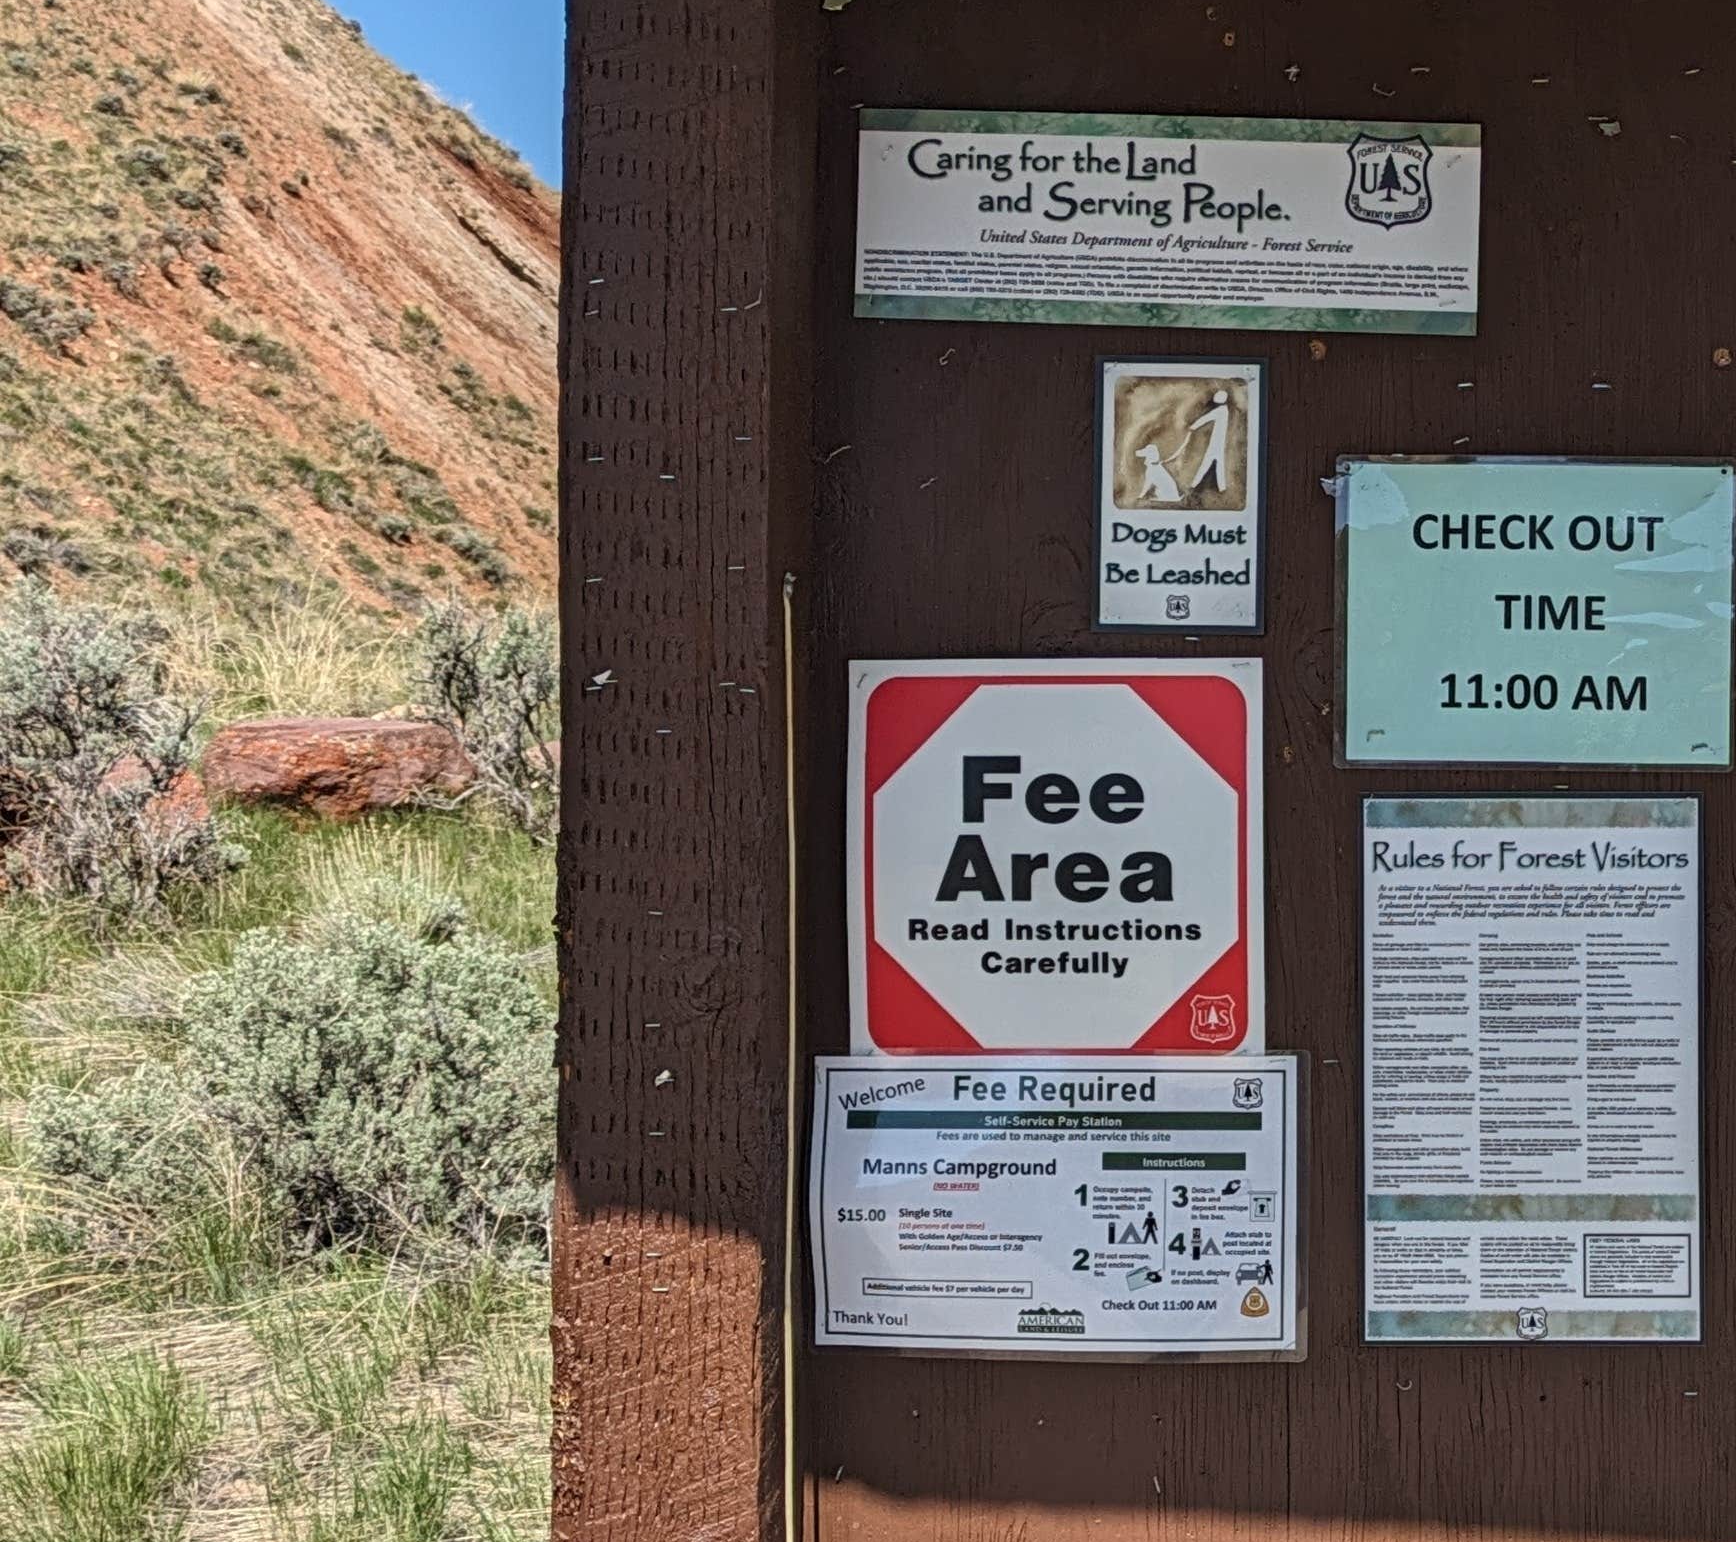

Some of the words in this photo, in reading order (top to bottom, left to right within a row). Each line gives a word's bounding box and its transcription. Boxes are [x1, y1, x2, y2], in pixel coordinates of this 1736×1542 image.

[907, 138, 1012, 181] Caring
[1020, 141, 1062, 172] for
[1073, 142, 1121, 173] the
[1126, 141, 1195, 180] Land
[978, 182, 1032, 213] and
[1043, 181, 1172, 226] Serving
[1182, 182, 1291, 233] People.
[980, 228, 1027, 243] United
[1029, 230, 1068, 245] States
[1071, 231, 1153, 249] Department
[1156, 234, 1173, 251] of
[1173, 234, 1249, 252] Agriculture
[1262, 237, 1303, 251] Forest
[1305, 238, 1353, 253] Service
[1111, 522, 1178, 553] Dogs
[1184, 524, 1247, 544] Must
[1413, 514, 1554, 550] CHECK
[1568, 515, 1664, 552] OUT
[1105, 563, 1140, 583] Be
[1146, 557, 1250, 585] Leashed
[1495, 594, 1606, 630] TIME
[1440, 673, 1558, 710] 11:00
[1571, 675, 1648, 710] AM
[962, 755, 1145, 824] Fee
[1372, 840, 1445, 872] Rules
[1451, 839, 1493, 869] for
[1498, 840, 1587, 872] Forest
[1591, 841, 1690, 871] Visitors
[935, 834, 1174, 903] Area
[908, 919, 989, 941] Read
[1004, 918, 1202, 941] Instructions
[981, 951, 1129, 978] Carefully
[838, 1078, 926, 1109] Welcome
[953, 1075, 1006, 1101] Fee
[1019, 1075, 1156, 1108] Required
[984, 1116, 1055, 1127] Self-Service
[1058, 1117, 1078, 1128] Pay
[1082, 1117, 1122, 1127] Station
[936, 1131, 959, 1140] Fees
[962, 1132, 979, 1141] are
[982, 1131, 1006, 1141] used
[1009, 1132, 1020, 1141] to
[1023, 1133, 1065, 1143] manage
[1068, 1131, 1087, 1141] and
[1090, 1132, 1127, 1141] service
[1130, 1132, 1150, 1141] this
[1151, 1132, 1171, 1141] site
[863, 1159, 927, 1175] Manns
[933, 1158, 1056, 1179] Campground
[1143, 1158, 1206, 1168] Instructions
[1074, 1184, 1087, 1207] 1
[1093, 1186, 1119, 1194] Occupy
[1171, 1185, 1189, 1208] 3
[837, 1208, 886, 1223] $15.00
[899, 1208, 930, 1219] Single
[933, 1208, 952, 1218] Site
[1168, 1232, 1186, 1255] 4
[1072, 1248, 1090, 1271] 2
[956, 1286, 968, 1294] per
[997, 1286, 1009, 1295] per
[1011, 1286, 1025, 1295] day
[1102, 1299, 1135, 1310] Check
[1138, 1299, 1159, 1310] Out
[1163, 1300, 1194, 1310] 11:00
[1197, 1300, 1217, 1310] AM
[833, 1310, 874, 1325] Thank
[877, 1311, 908, 1326] You!
[1019, 1315, 1085, 1325] AMERICAN
